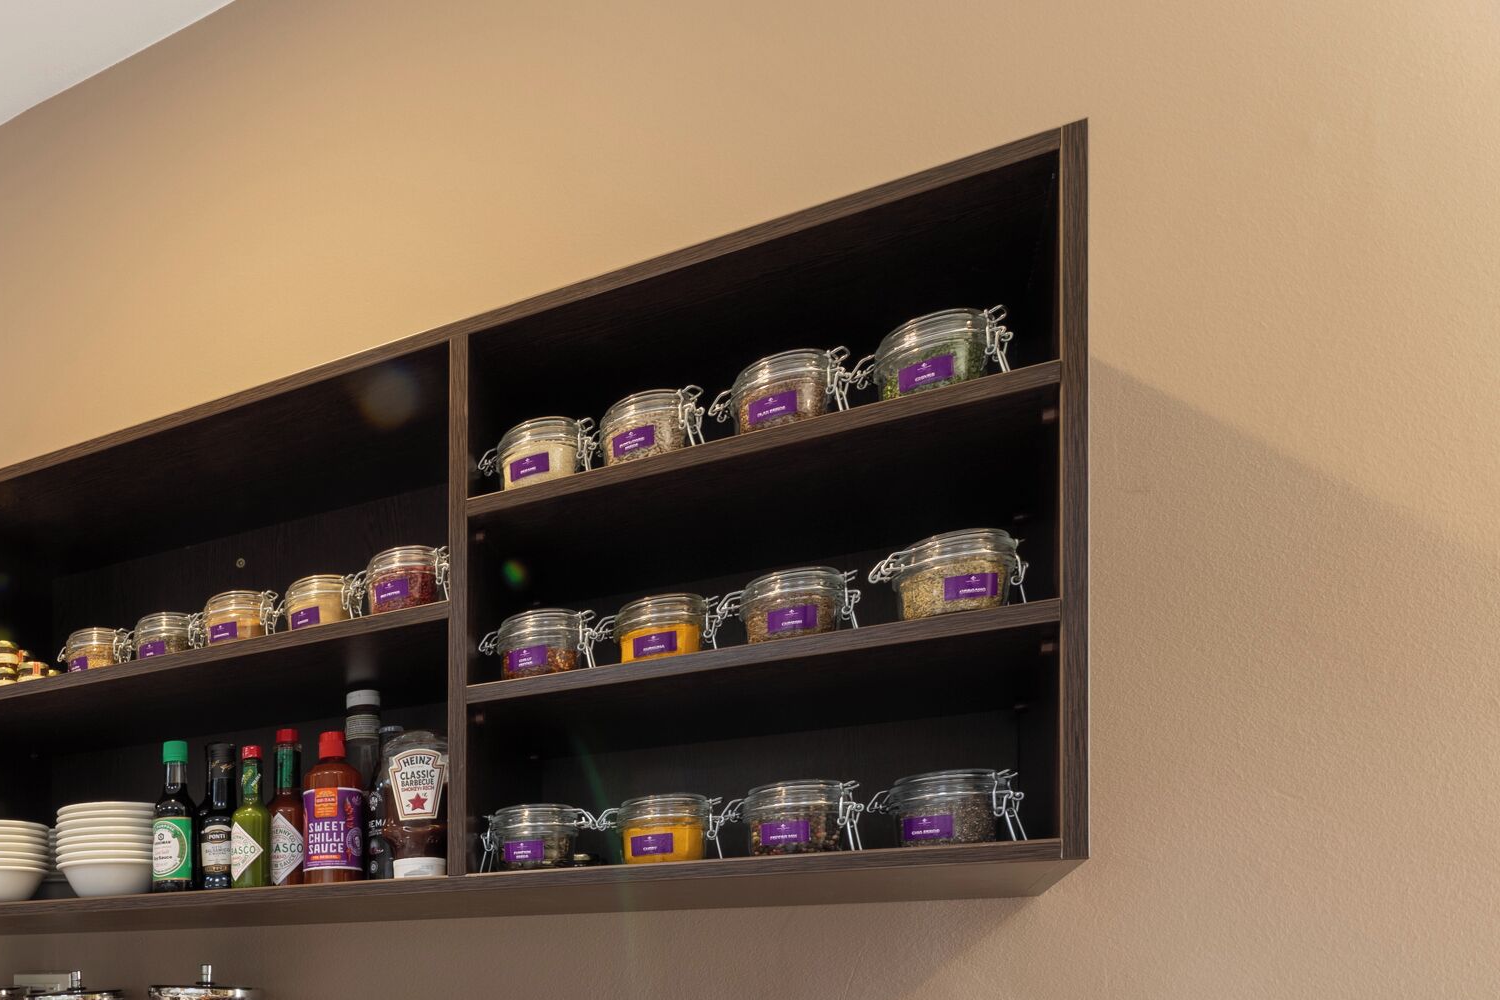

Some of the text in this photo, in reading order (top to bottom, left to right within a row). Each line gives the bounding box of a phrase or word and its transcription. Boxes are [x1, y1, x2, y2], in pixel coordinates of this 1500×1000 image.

[402, 756, 432, 767] HEINZ
[400, 769, 435, 780] CLASSIC
[401, 779, 434, 787] BARBECUE
[308, 821, 346, 833] SWEET
[308, 832, 344, 844] CHILLI
[308, 842, 344, 855] SAUCE
